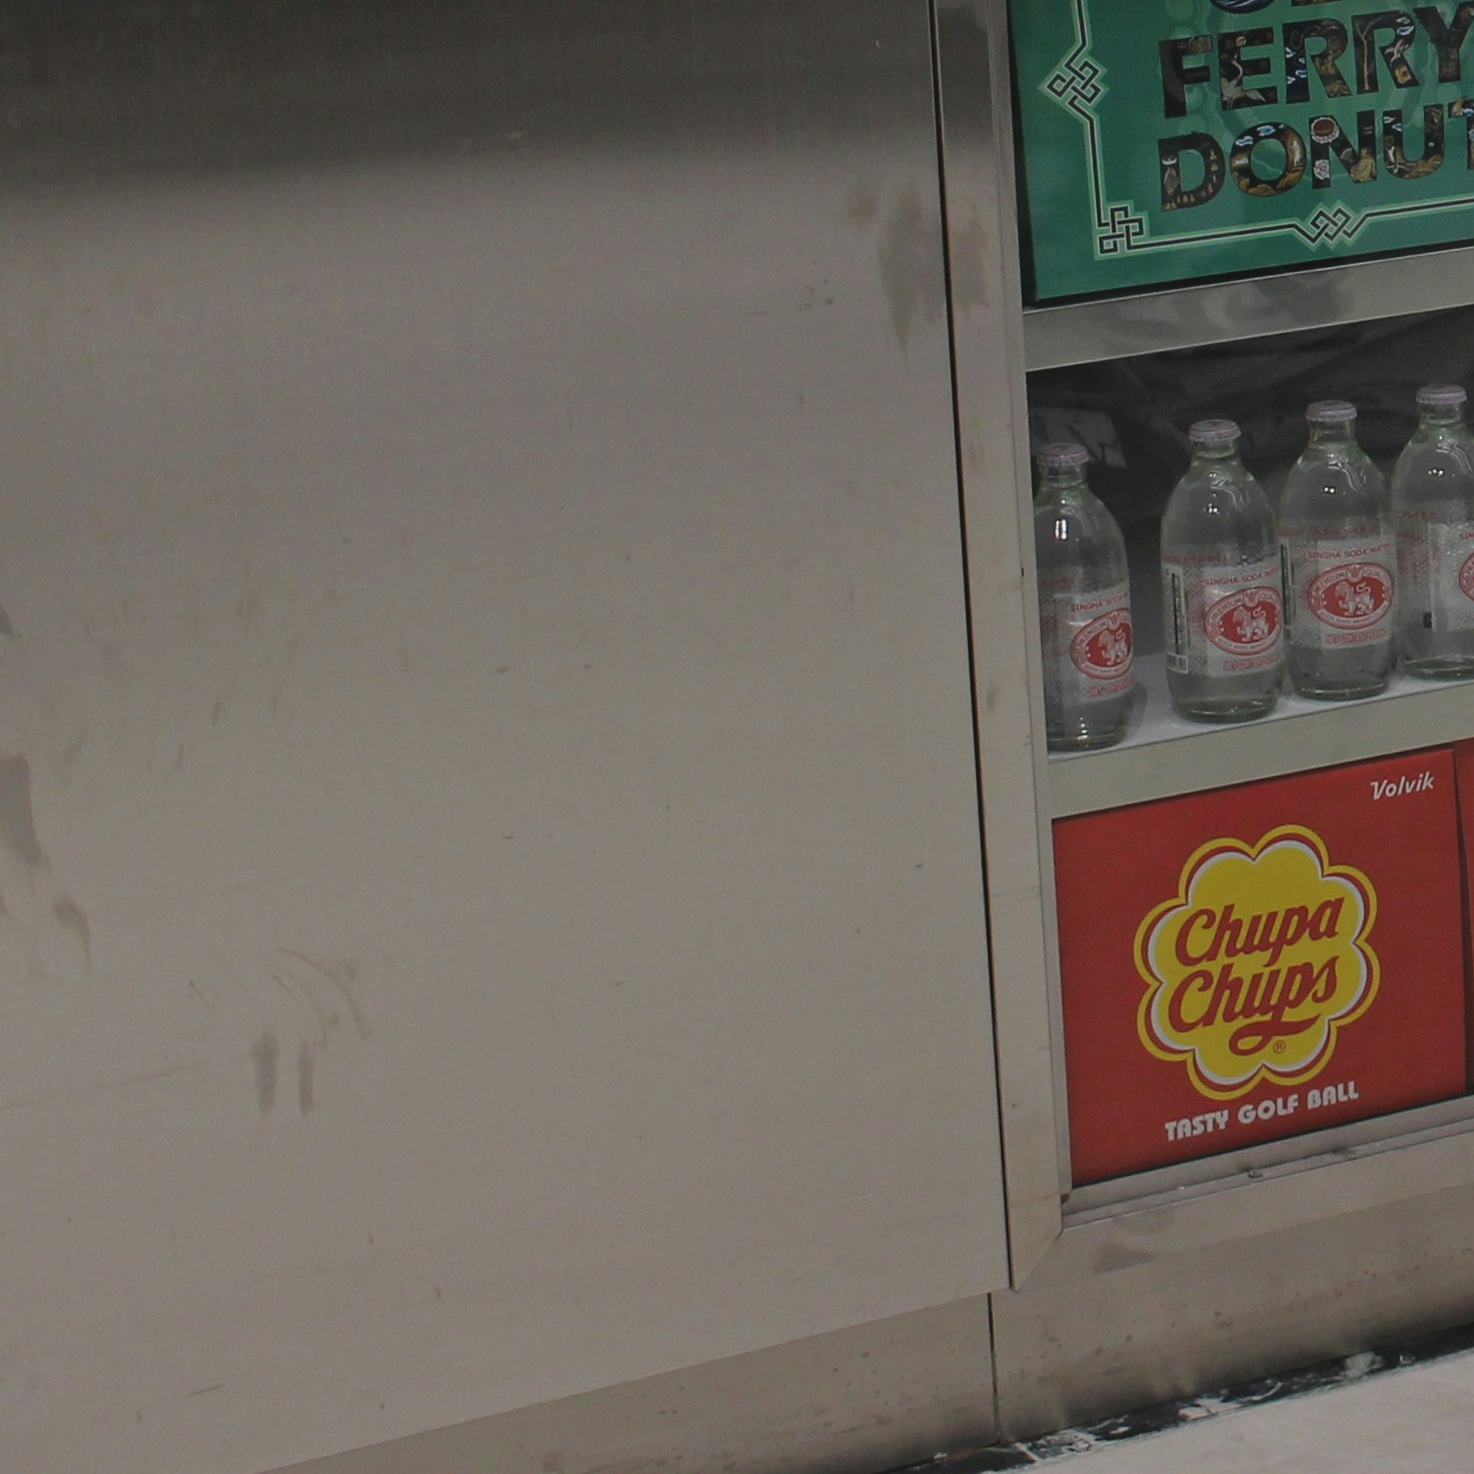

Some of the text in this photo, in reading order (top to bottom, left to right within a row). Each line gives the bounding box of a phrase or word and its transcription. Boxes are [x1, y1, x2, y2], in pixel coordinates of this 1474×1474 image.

[1370, 771, 1435, 800] Volvik
[1175, 896, 1344, 967] Chupa
[1168, 956, 1340, 1056] Chups
[1164, 1081, 1360, 1141] TASTY GOLF BALL
